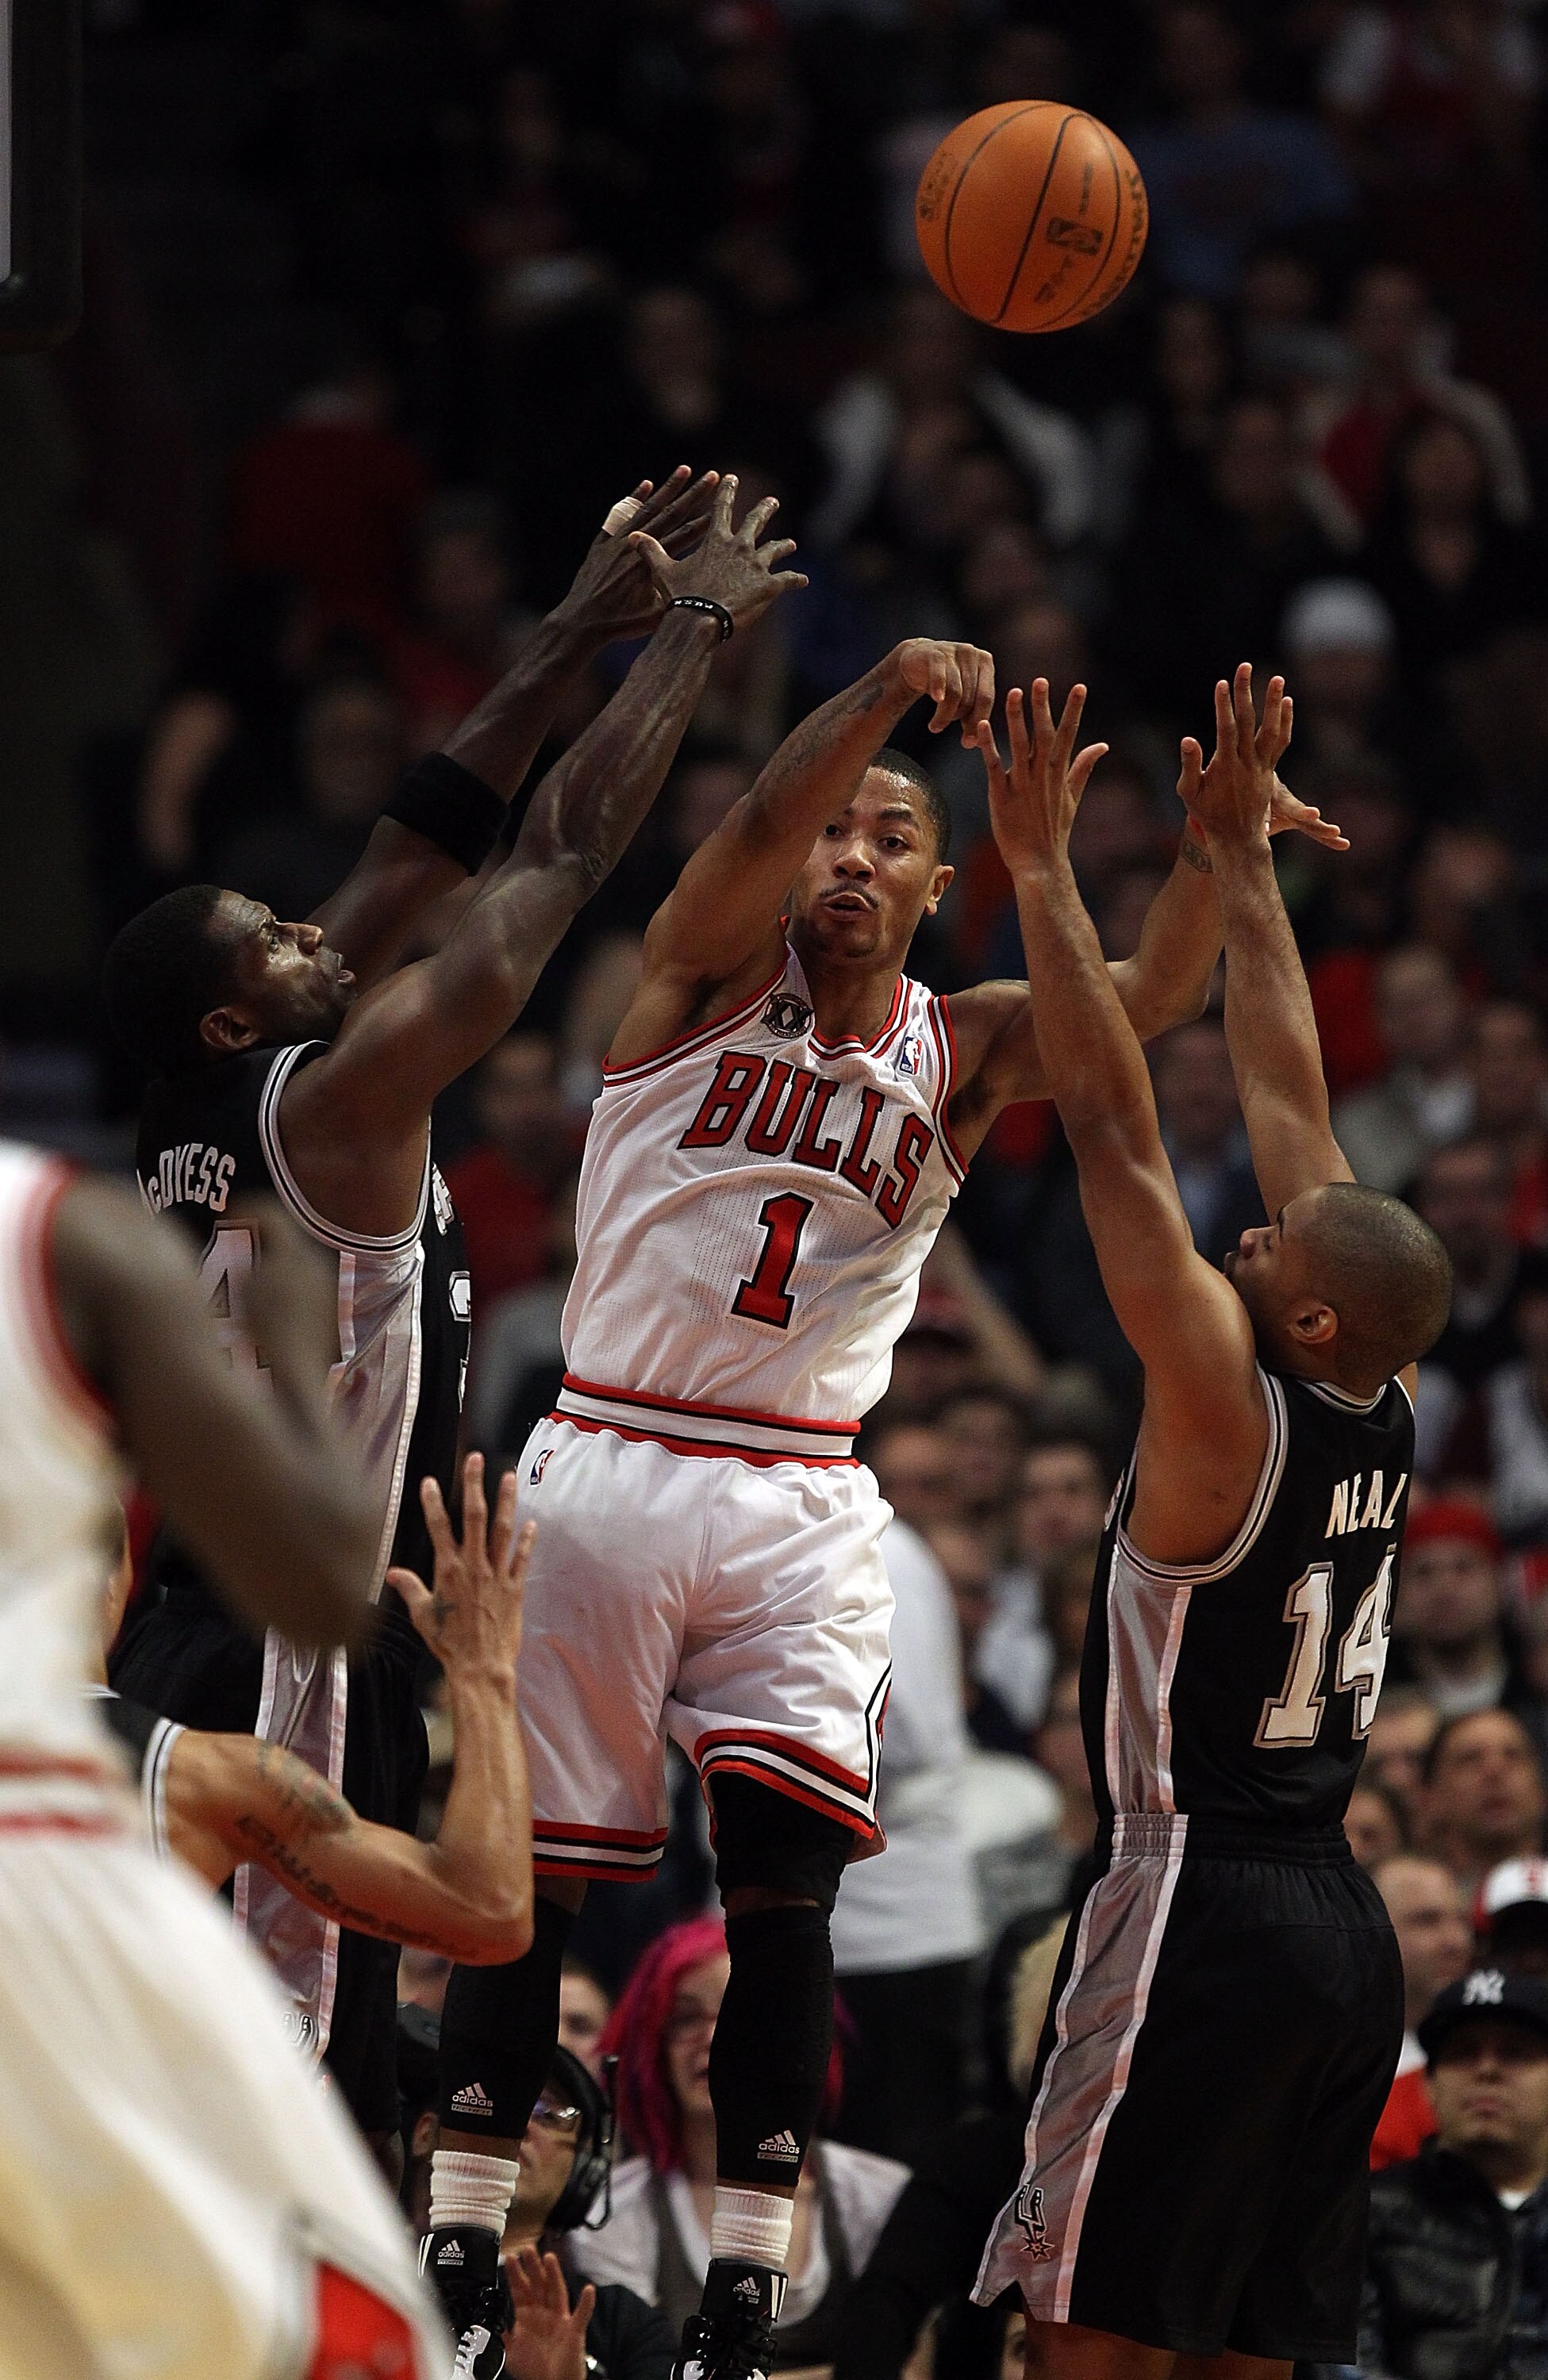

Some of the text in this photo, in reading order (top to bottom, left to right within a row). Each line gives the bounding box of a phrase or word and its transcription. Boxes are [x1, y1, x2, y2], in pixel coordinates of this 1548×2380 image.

[677, 1050, 935, 1230] BULLS
[731, 1192, 815, 1330] 1
[1324, 1469, 1408, 1539] NEAL
[1251, 1541, 1397, 1749] 14
[451, 2094, 494, 2107] adidas
[759, 2143, 800, 2154] adidas
